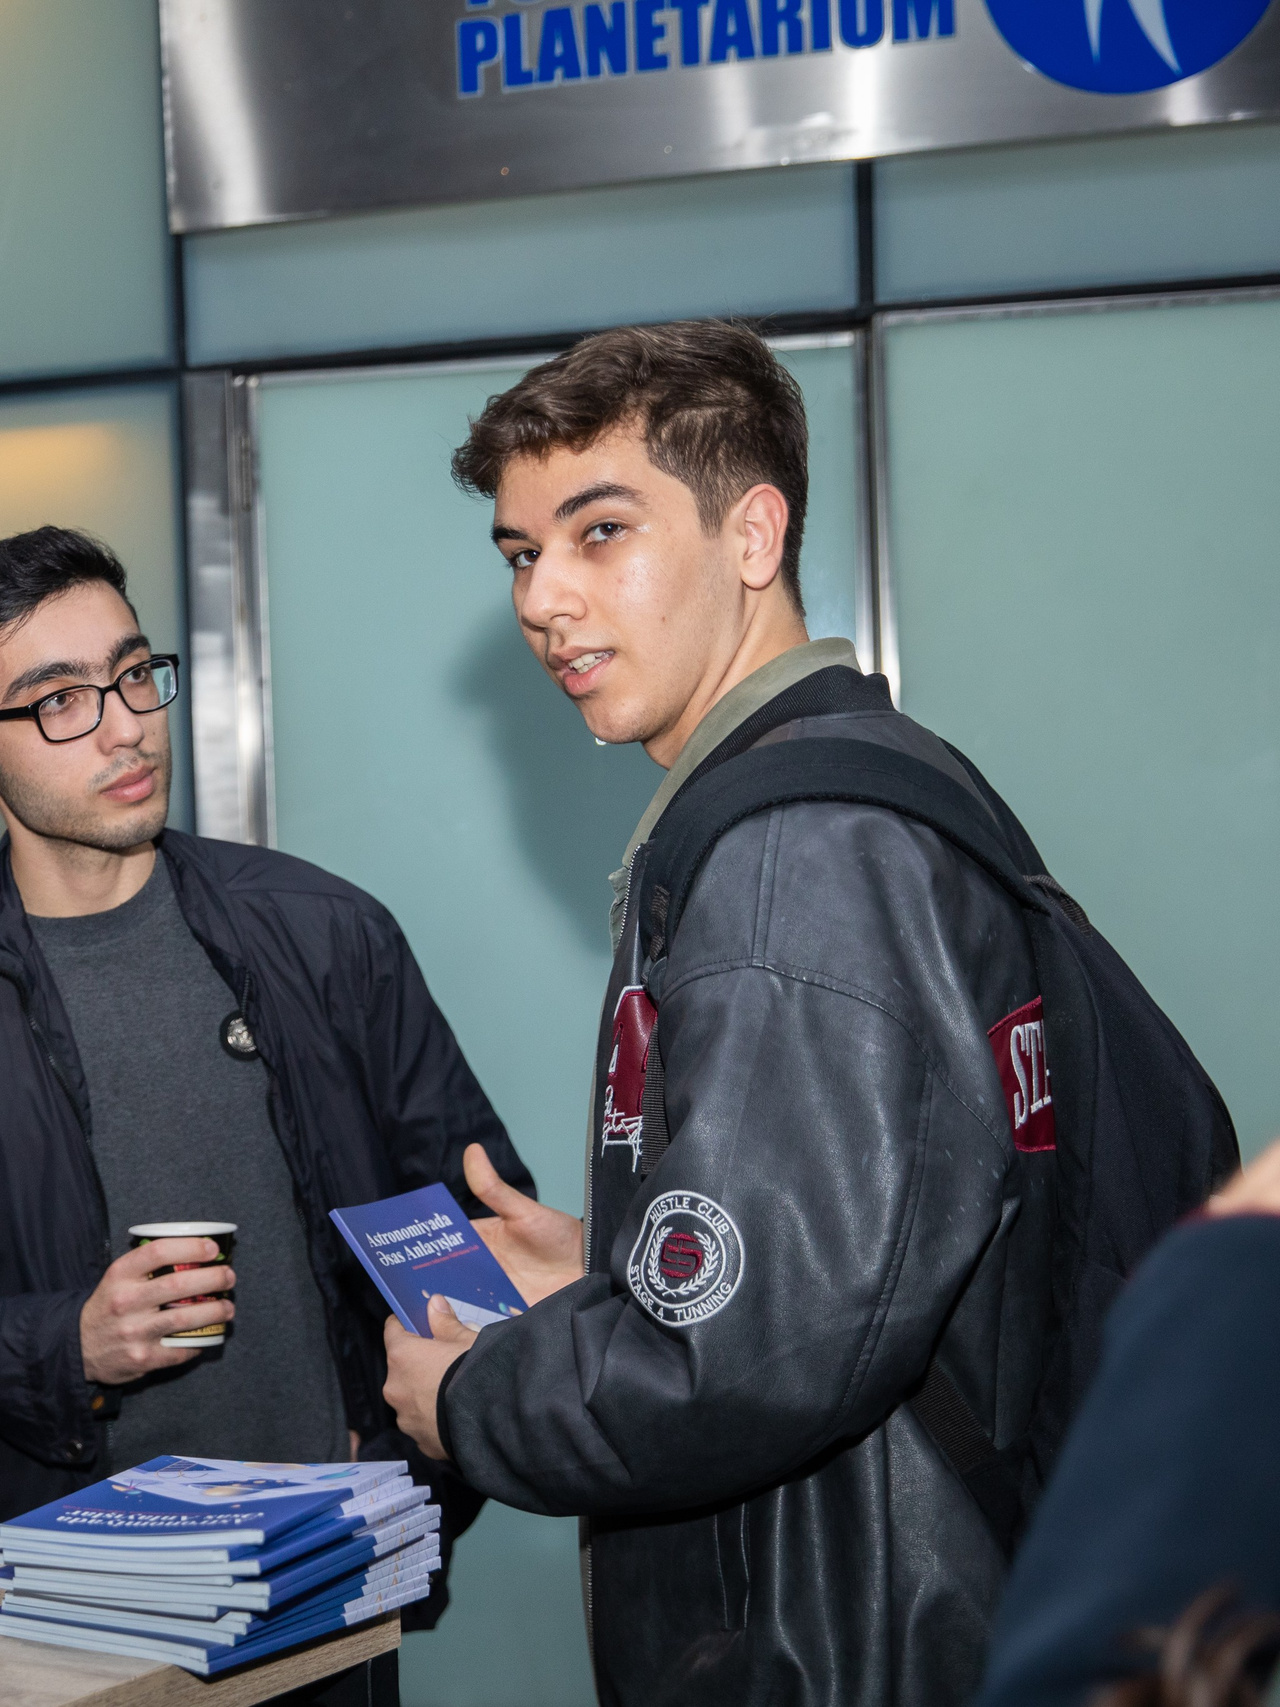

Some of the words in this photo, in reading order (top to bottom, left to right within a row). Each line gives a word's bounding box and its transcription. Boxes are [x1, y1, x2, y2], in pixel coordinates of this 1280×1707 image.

[458, 0, 957, 96] PLANETARIUM
[365, 1212, 454, 1248] Astronomiyada
[650, 1196, 691, 1225] HUSTLE
[697, 1201, 730, 1235] CLUB
[376, 1250, 406, 1267] Əsas
[403, 1231, 465, 1261] Anlayışlar
[630, 1264, 655, 1309] STAGE
[657, 1307, 665, 1320] 4
[673, 1281, 732, 1321] TUNNING
